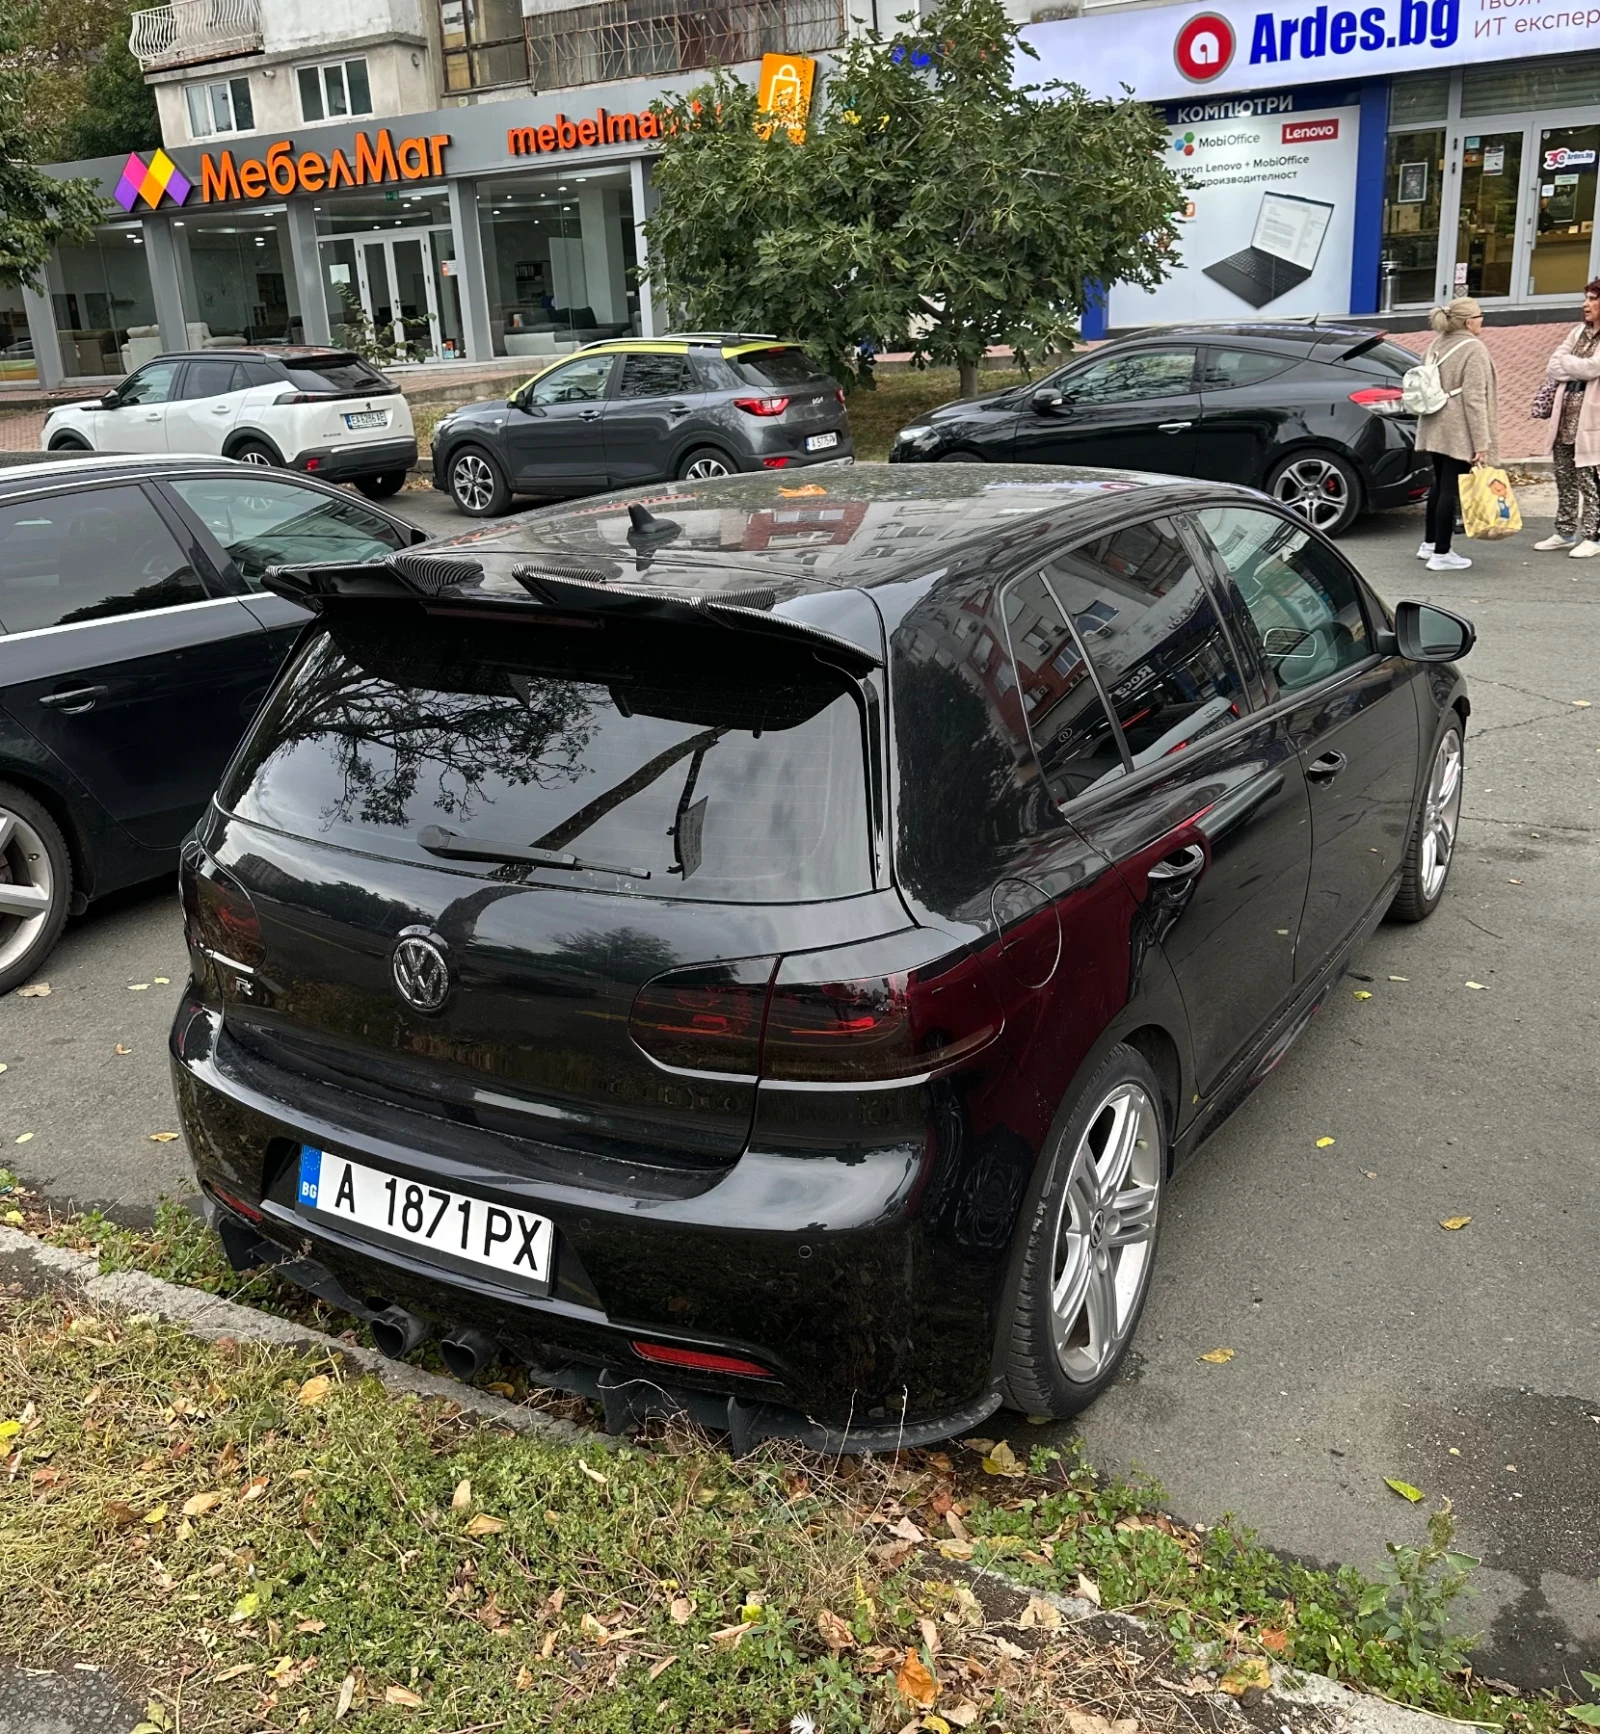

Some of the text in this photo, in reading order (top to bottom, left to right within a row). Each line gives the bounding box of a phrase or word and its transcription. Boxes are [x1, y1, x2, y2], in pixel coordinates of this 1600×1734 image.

[1249, 0, 1460, 49] Ardes.bg
[1474, 16, 1507, 38] ИТ
[1177, 95, 1293, 124] КОМПЮТРИ
[1198, 133, 1260, 149] MobiOffice
[1285, 125, 1335, 139] Lenovo
[201, 128, 450, 203] МебелМаг
[1170, 166, 1203, 176] аптоп
[1205, 161, 1242, 173] Lenovo
[1253, 155, 1310, 168] MobiOffice
[302, 1182, 318, 1199] BG
[335, 1163, 543, 1272] A 1871 PX
